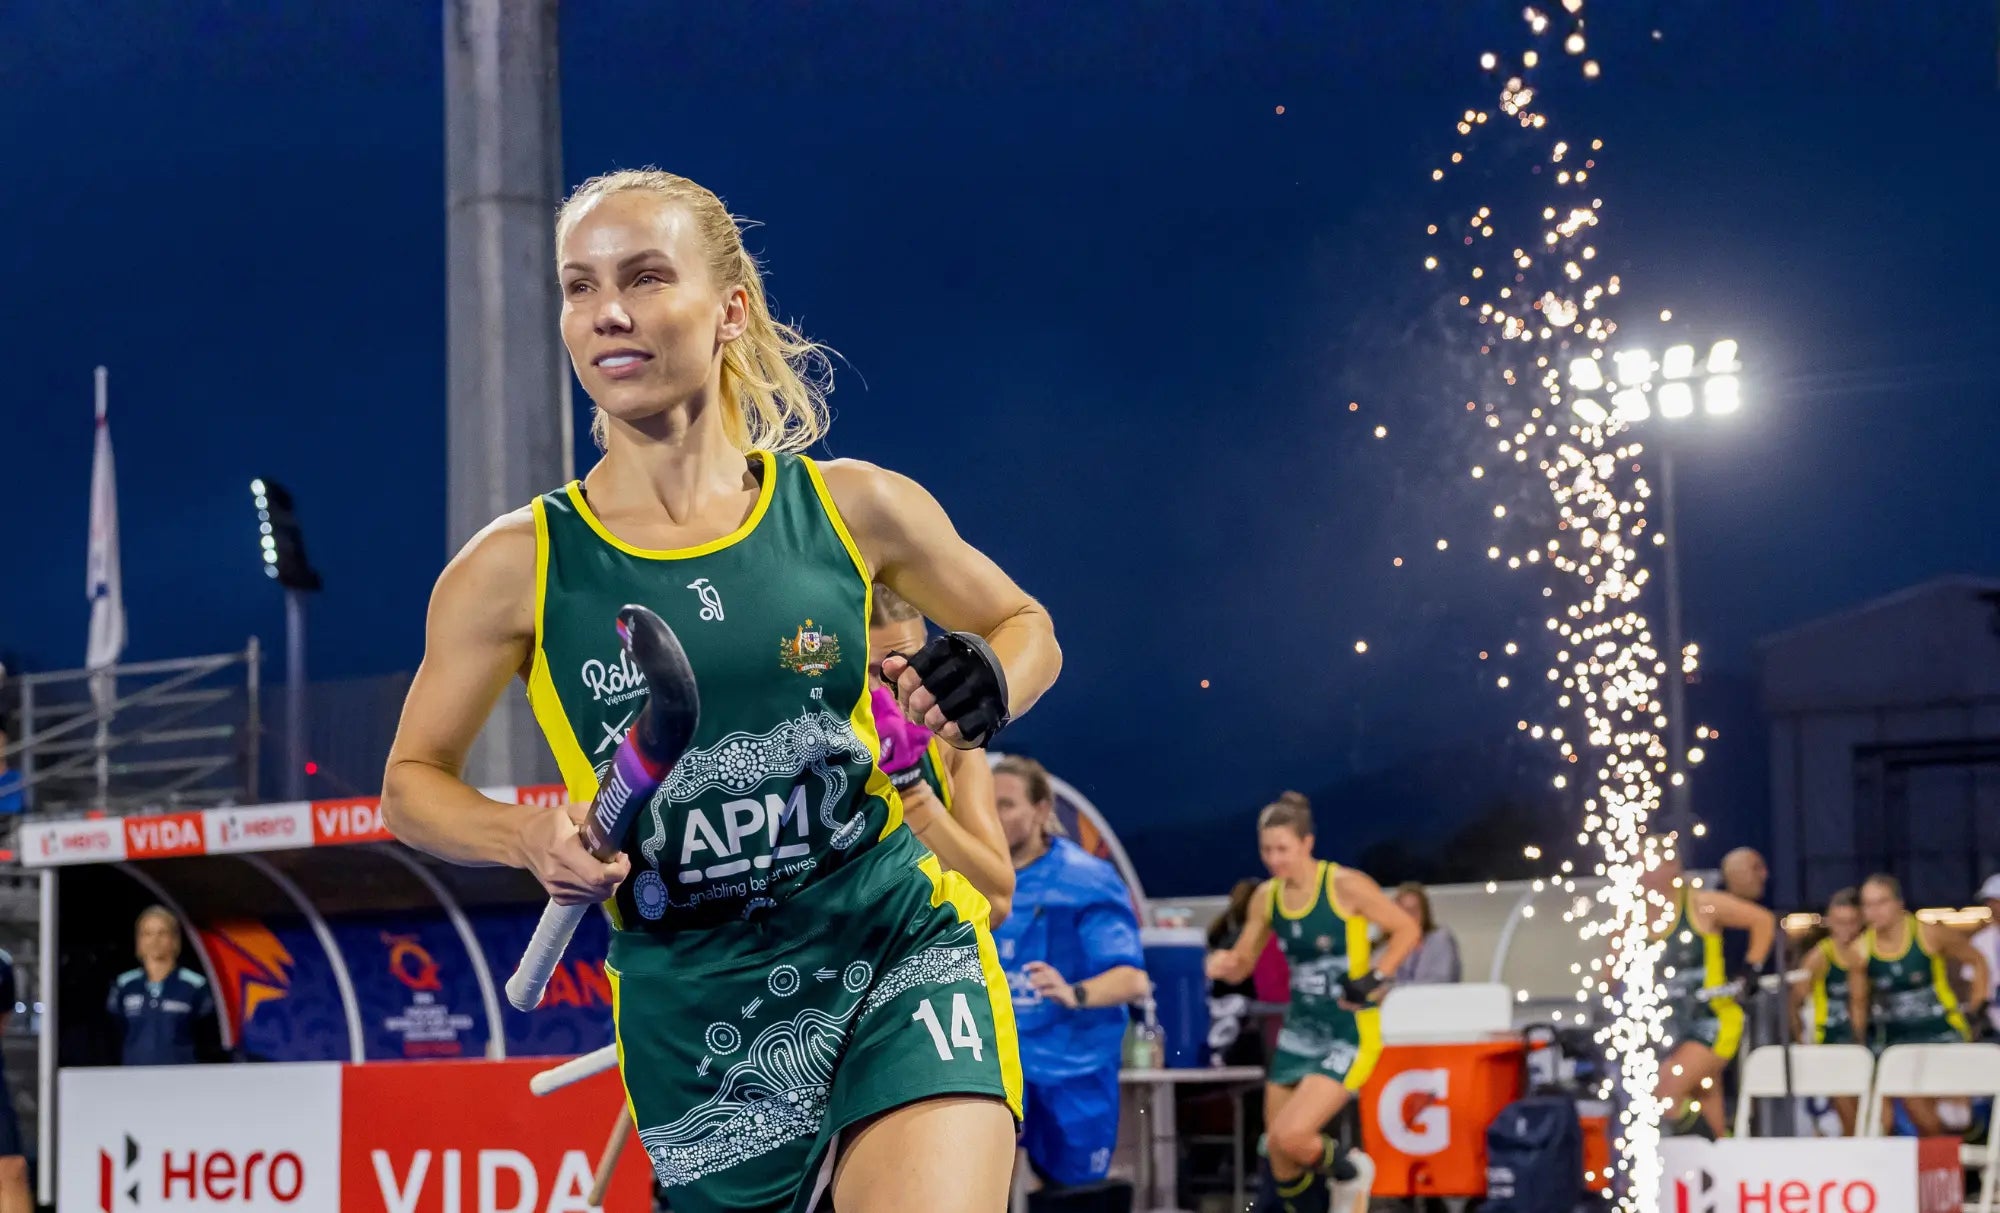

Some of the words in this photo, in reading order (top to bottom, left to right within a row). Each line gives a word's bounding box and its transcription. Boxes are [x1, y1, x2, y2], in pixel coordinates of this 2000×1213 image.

[810, 687, 823, 700] 479
[596, 762, 633, 835] ritual
[680, 784, 809, 865] APM
[128, 819, 200, 850] VIDA
[690, 880, 747, 905] enabling
[784, 857, 817, 876] lives
[912, 993, 983, 1062] 14
[1378, 1069, 1450, 1155] G
[163, 1150, 304, 1203] Hero
[371, 1149, 605, 1213] VIDA
[1738, 1179, 1878, 1213] Hero
